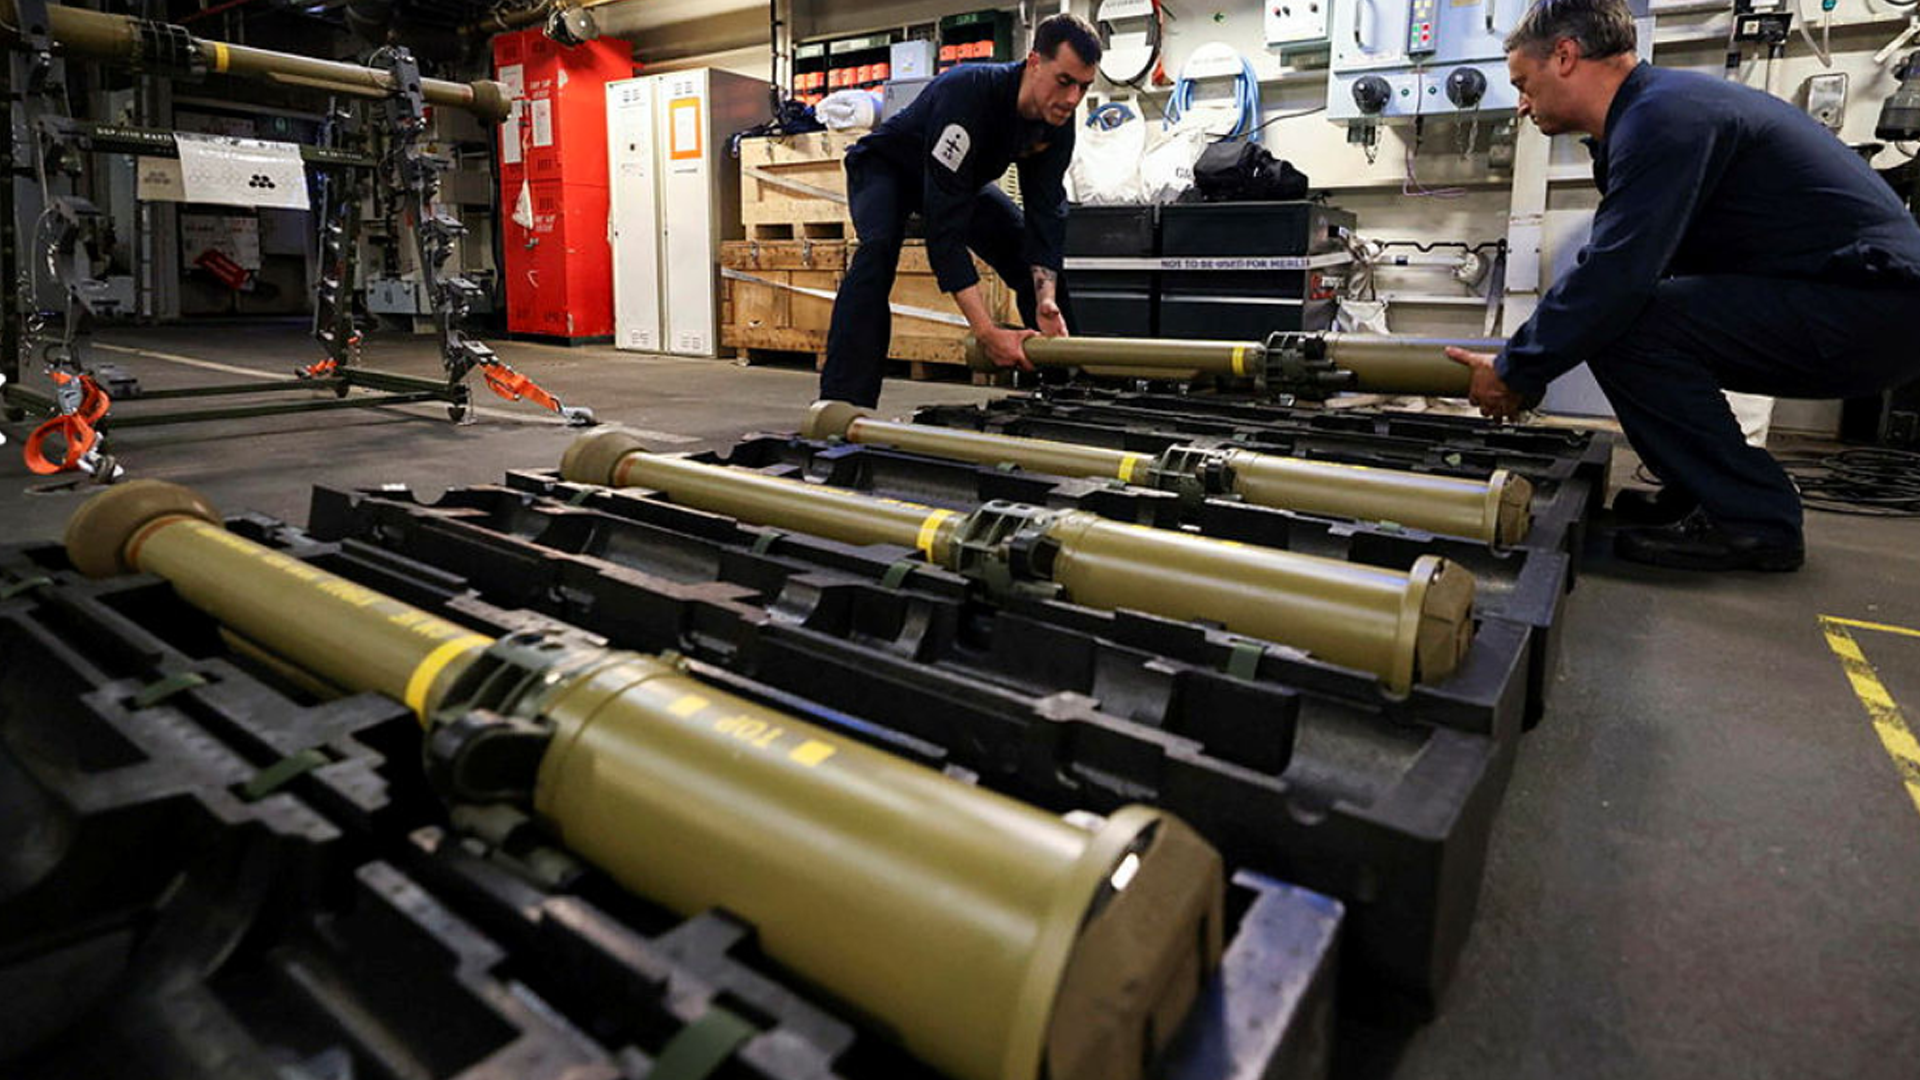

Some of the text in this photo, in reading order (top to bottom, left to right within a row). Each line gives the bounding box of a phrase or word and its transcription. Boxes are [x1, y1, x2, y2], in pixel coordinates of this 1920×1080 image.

[1161, 258, 1181, 268] NOT
[1185, 258, 1198, 268] TO
[1200, 258, 1213, 268] BE
[1246, 258, 1266, 268] FOR
[714, 714, 784, 748] TOP
